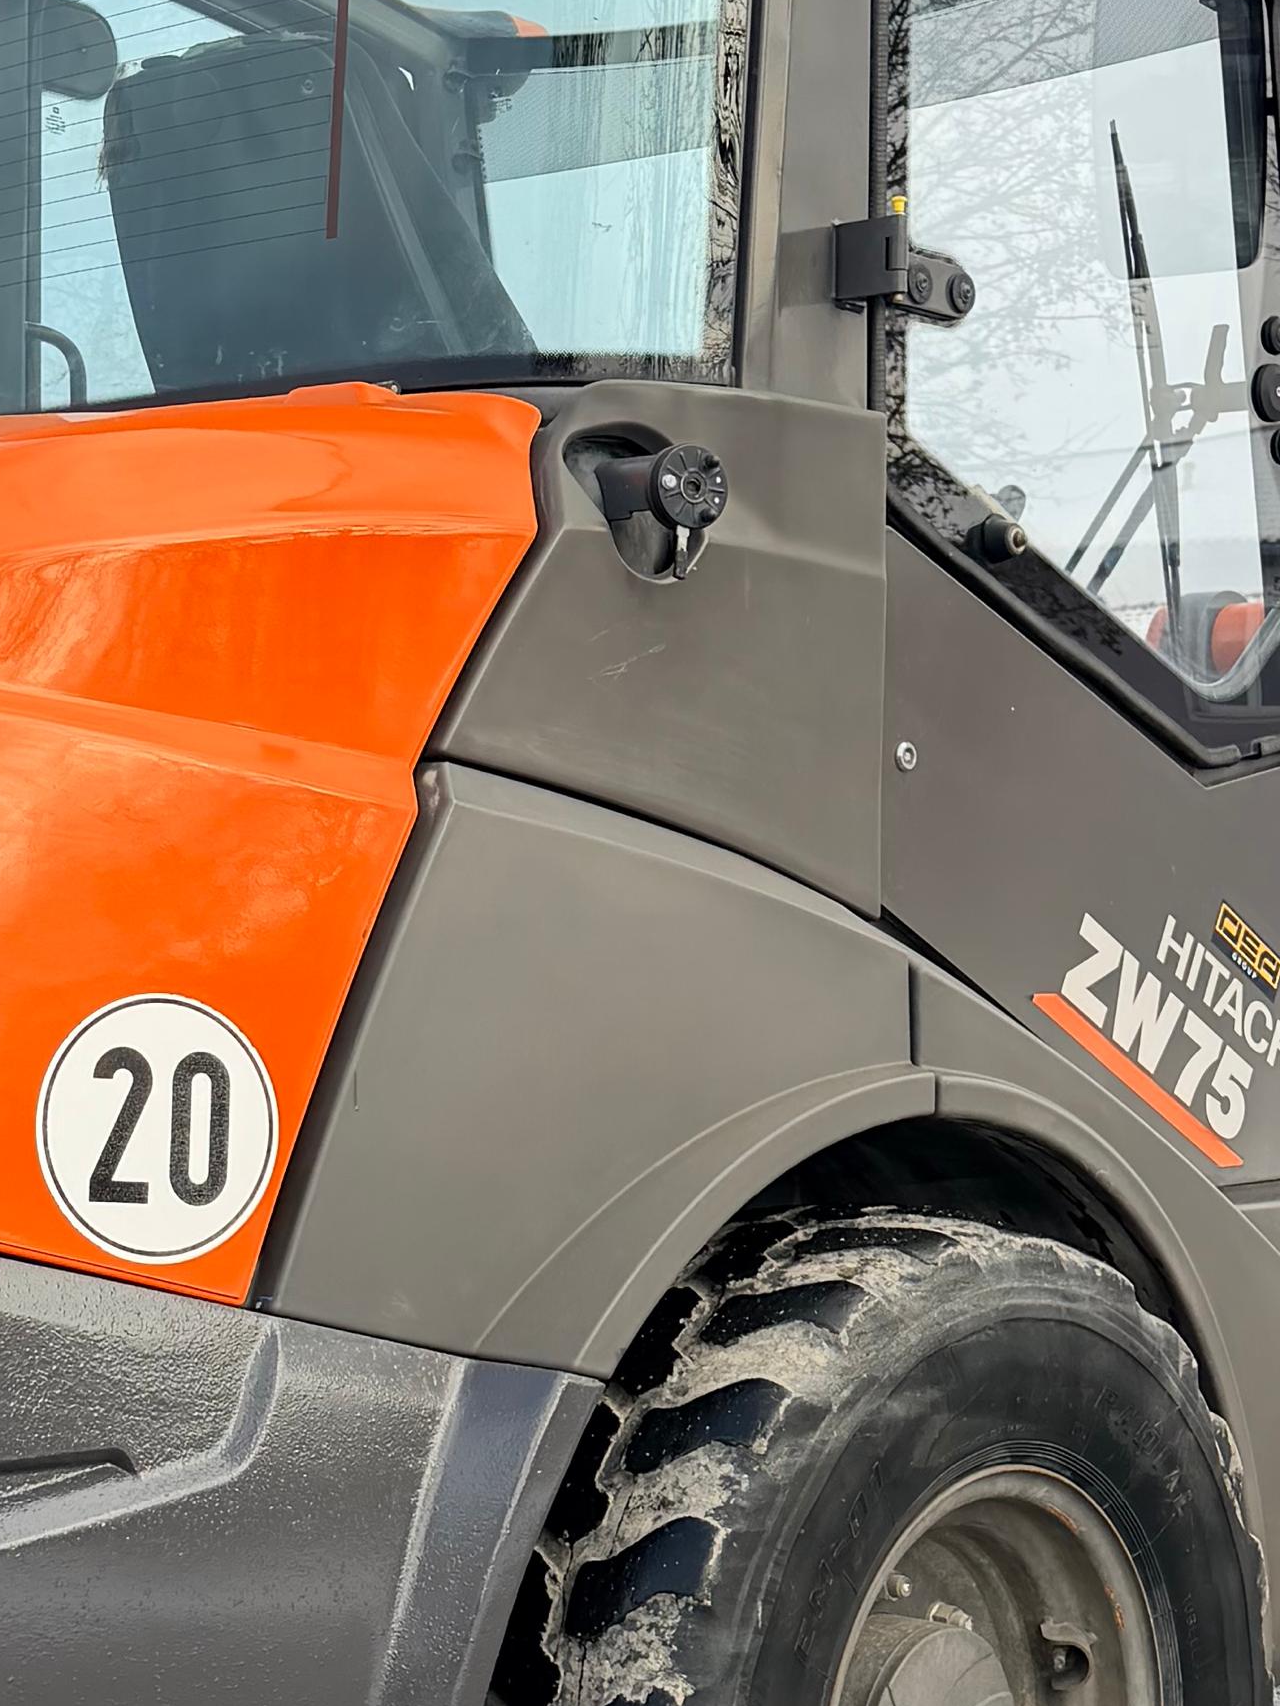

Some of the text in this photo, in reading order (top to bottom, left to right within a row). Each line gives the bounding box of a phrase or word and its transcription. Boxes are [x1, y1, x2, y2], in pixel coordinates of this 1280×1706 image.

[1060, 912, 1254, 1141] ZW75
[1231, 951, 1258, 980] GROUP
[88, 1045, 231, 1207] 20
